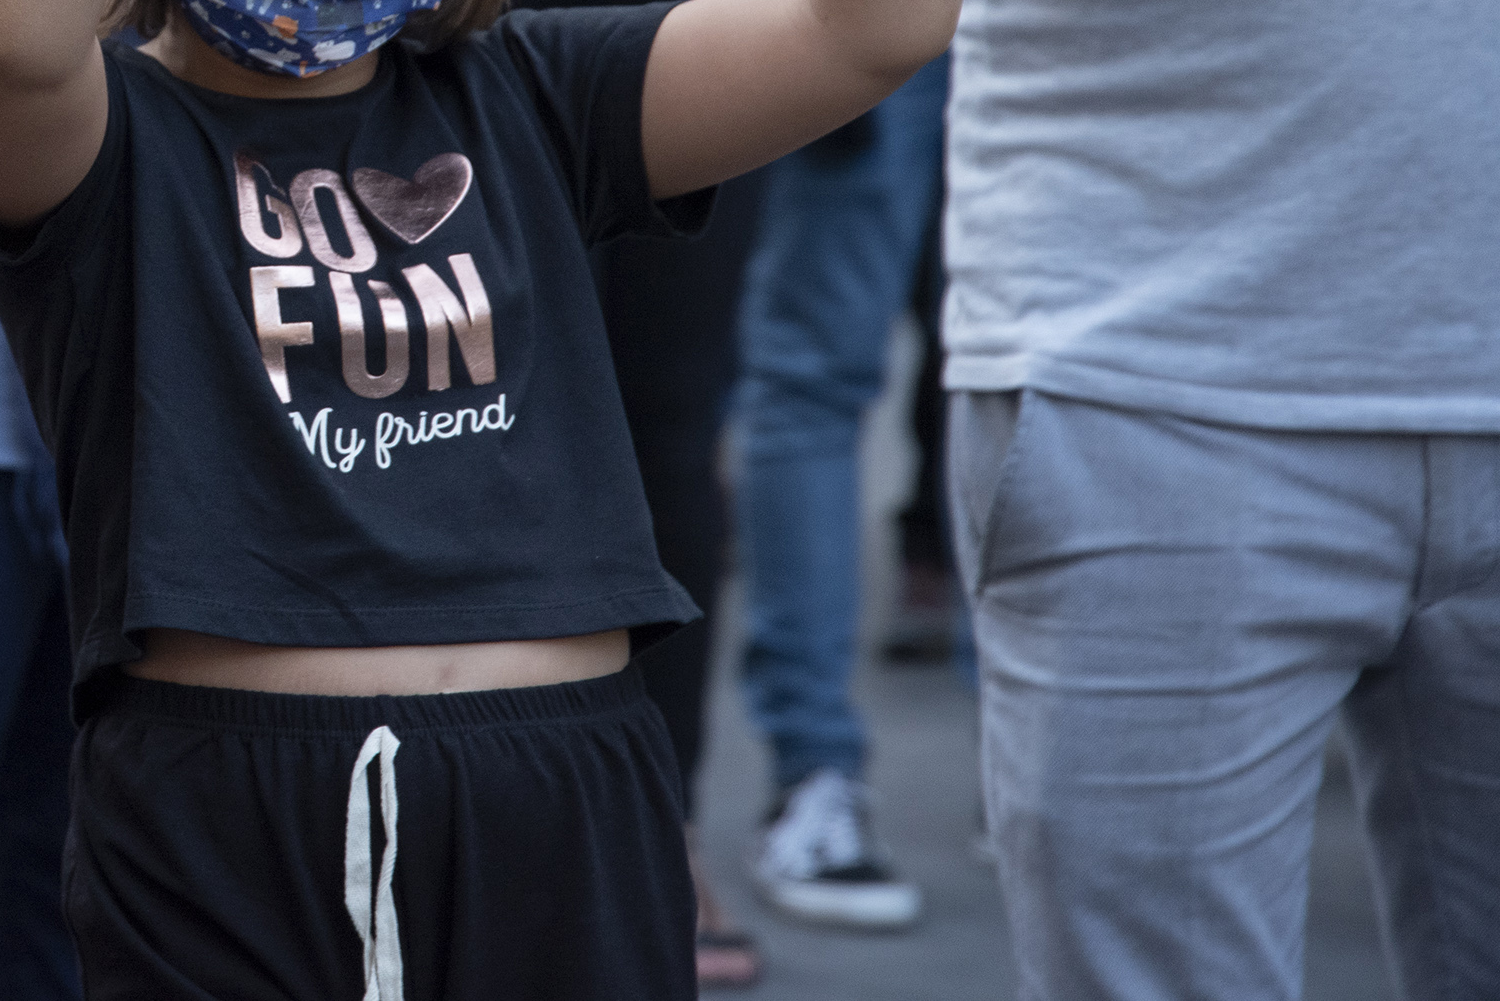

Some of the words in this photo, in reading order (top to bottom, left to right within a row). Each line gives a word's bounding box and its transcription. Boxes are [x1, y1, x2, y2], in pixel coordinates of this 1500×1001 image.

[232, 148, 378, 274] GO
[249, 252, 497, 404] FUN
[288, 406, 367, 474] My
[374, 392, 516, 470] friend
